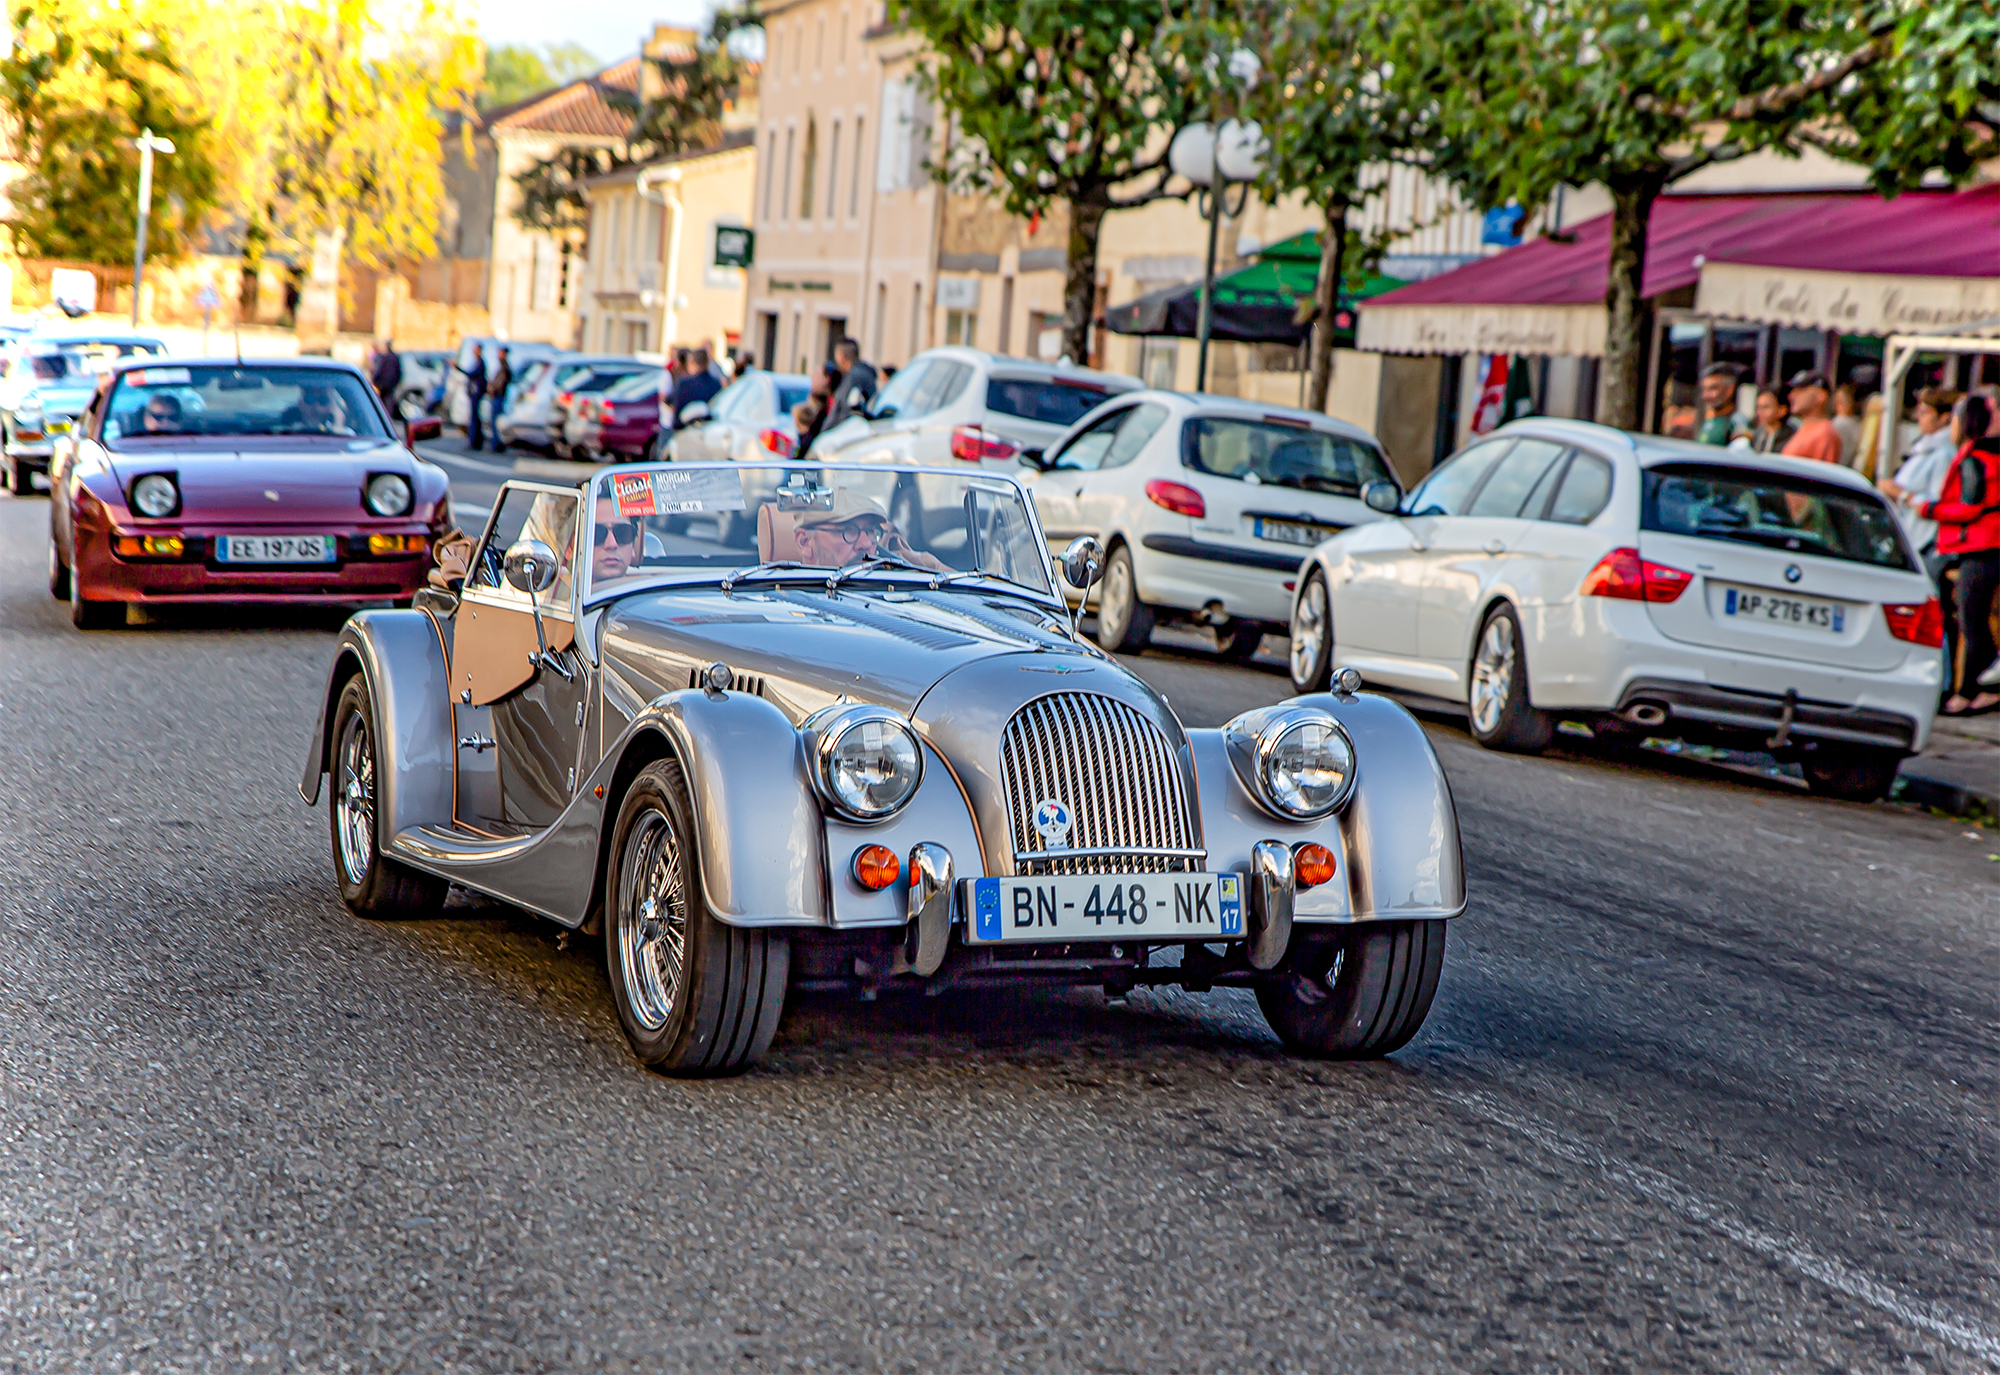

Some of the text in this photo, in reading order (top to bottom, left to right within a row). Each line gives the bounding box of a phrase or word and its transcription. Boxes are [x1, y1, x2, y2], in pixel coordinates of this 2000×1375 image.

[1829, 286, 1860, 320] du
[614, 477, 653, 497] Classic
[655, 472, 691, 485] MORGAN
[984, 913, 993, 928] F
[1222, 908, 1240, 931] 17
